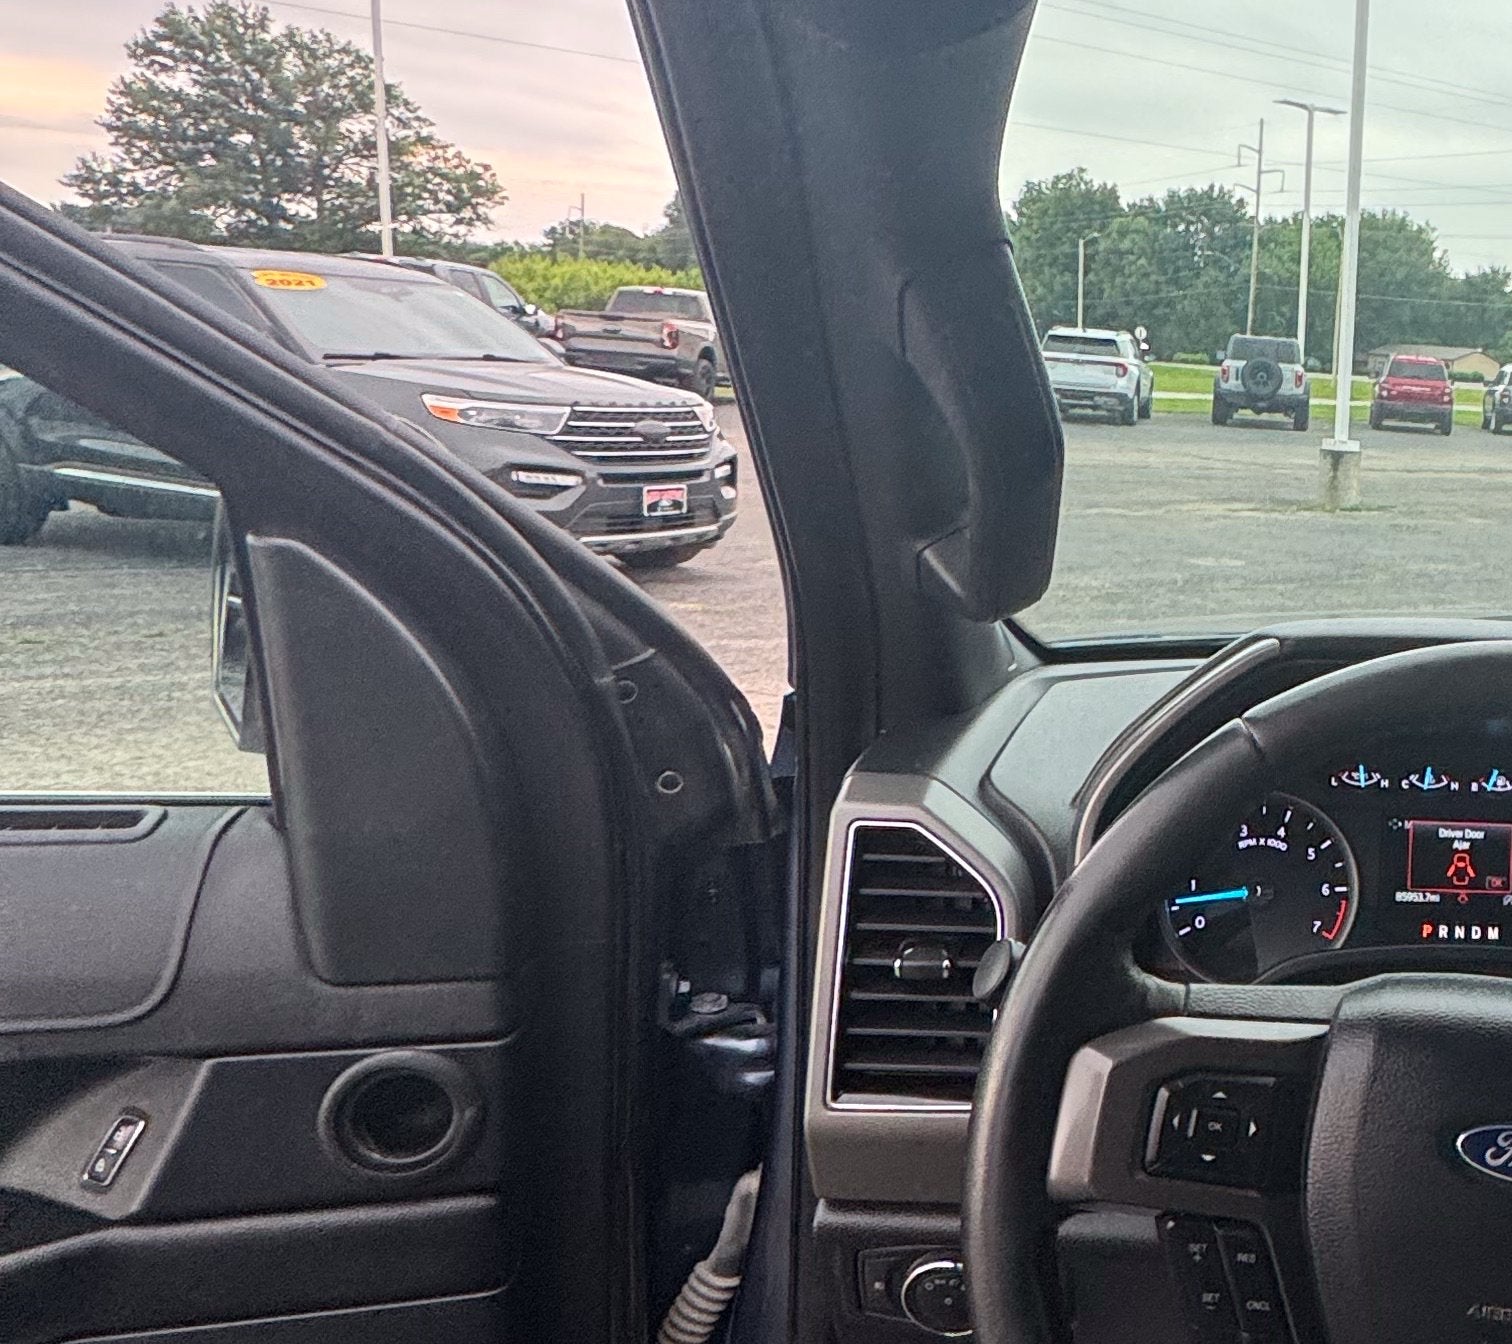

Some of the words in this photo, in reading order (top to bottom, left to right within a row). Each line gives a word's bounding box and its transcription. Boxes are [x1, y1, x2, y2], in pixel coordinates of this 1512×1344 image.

[265, 278, 316, 287] 2021
[1240, 824, 1248, 836] 3
[1277, 826, 1286, 838] 4
[1438, 828, 1463, 839] Driver
[1464, 829, 1485, 840] Door
[1237, 839, 1257, 850] RPM
[1267, 839, 1288, 852] 1000
[1452, 840, 1471, 851] Ajar
[1307, 848, 1316, 860] 5
[1321, 883, 1330, 896] 6
[1194, 916, 1205, 929] 0
[1312, 921, 1322, 933] 7
[1423, 925, 1433, 938] P
[1438, 925, 1448, 938] R
[1454, 925, 1465, 939] N
[1471, 926, 1481, 940] D
[1487, 926, 1499, 940] M
[1207, 1122, 1223, 1132] OK
